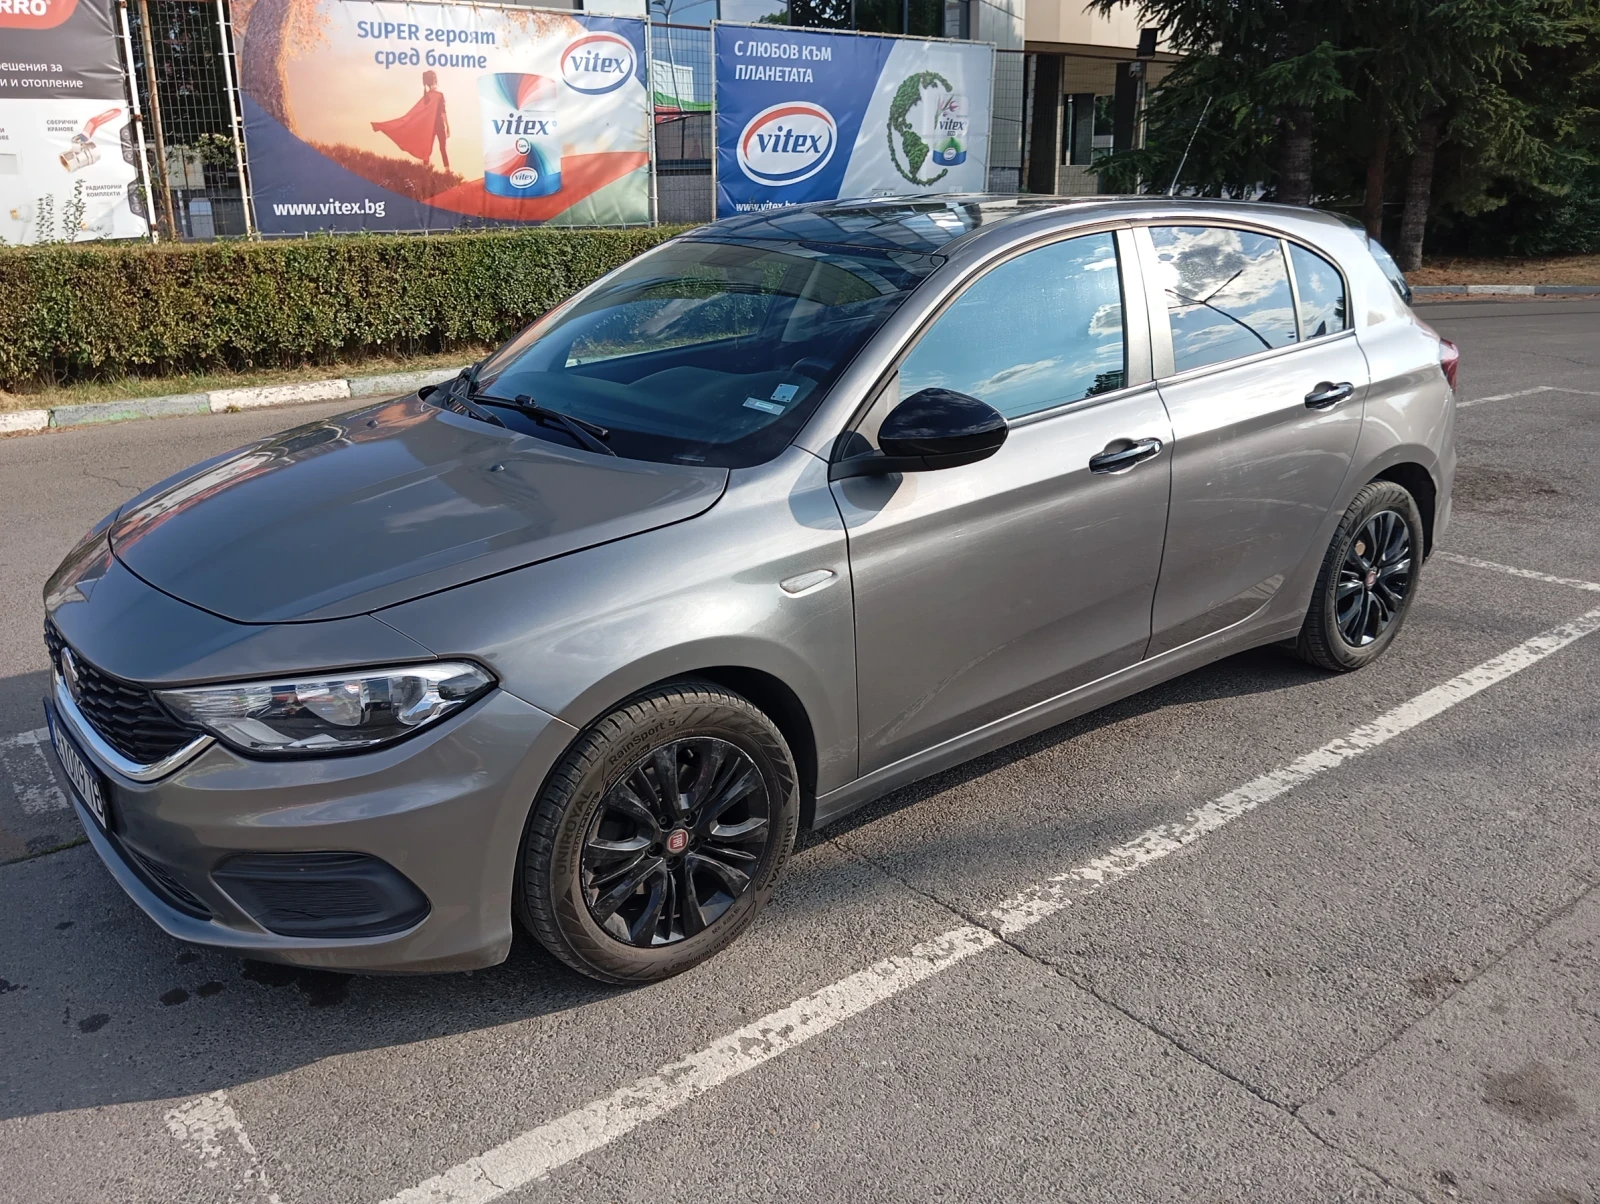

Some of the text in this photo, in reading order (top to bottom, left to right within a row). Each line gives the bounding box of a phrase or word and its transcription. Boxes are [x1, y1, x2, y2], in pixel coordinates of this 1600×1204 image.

[357, 20, 496, 47] SUPER героят
[374, 47, 487, 69] сред боите
[570, 50, 625, 73] vitex
[734, 40, 832, 61] С ЛЮБОВ КЪМ
[0, 62, 63, 72] ешения за
[735, 64, 814, 83] ПЛАНЕТАТА
[10, 78, 19, 87] и
[21, 78, 84, 88] отопление
[492, 113, 549, 135] vitex
[939, 117, 964, 130] vitex
[757, 125, 822, 153] vitex
[515, 172, 533, 181] vitex
[273, 198, 386, 217] www.vitex.bg
[609, 722, 666, 766] RainSport
[668, 717, 676, 727] 5
[557, 790, 593, 876] UNIROYAL
[764, 816, 794, 892] UNIROYAL
